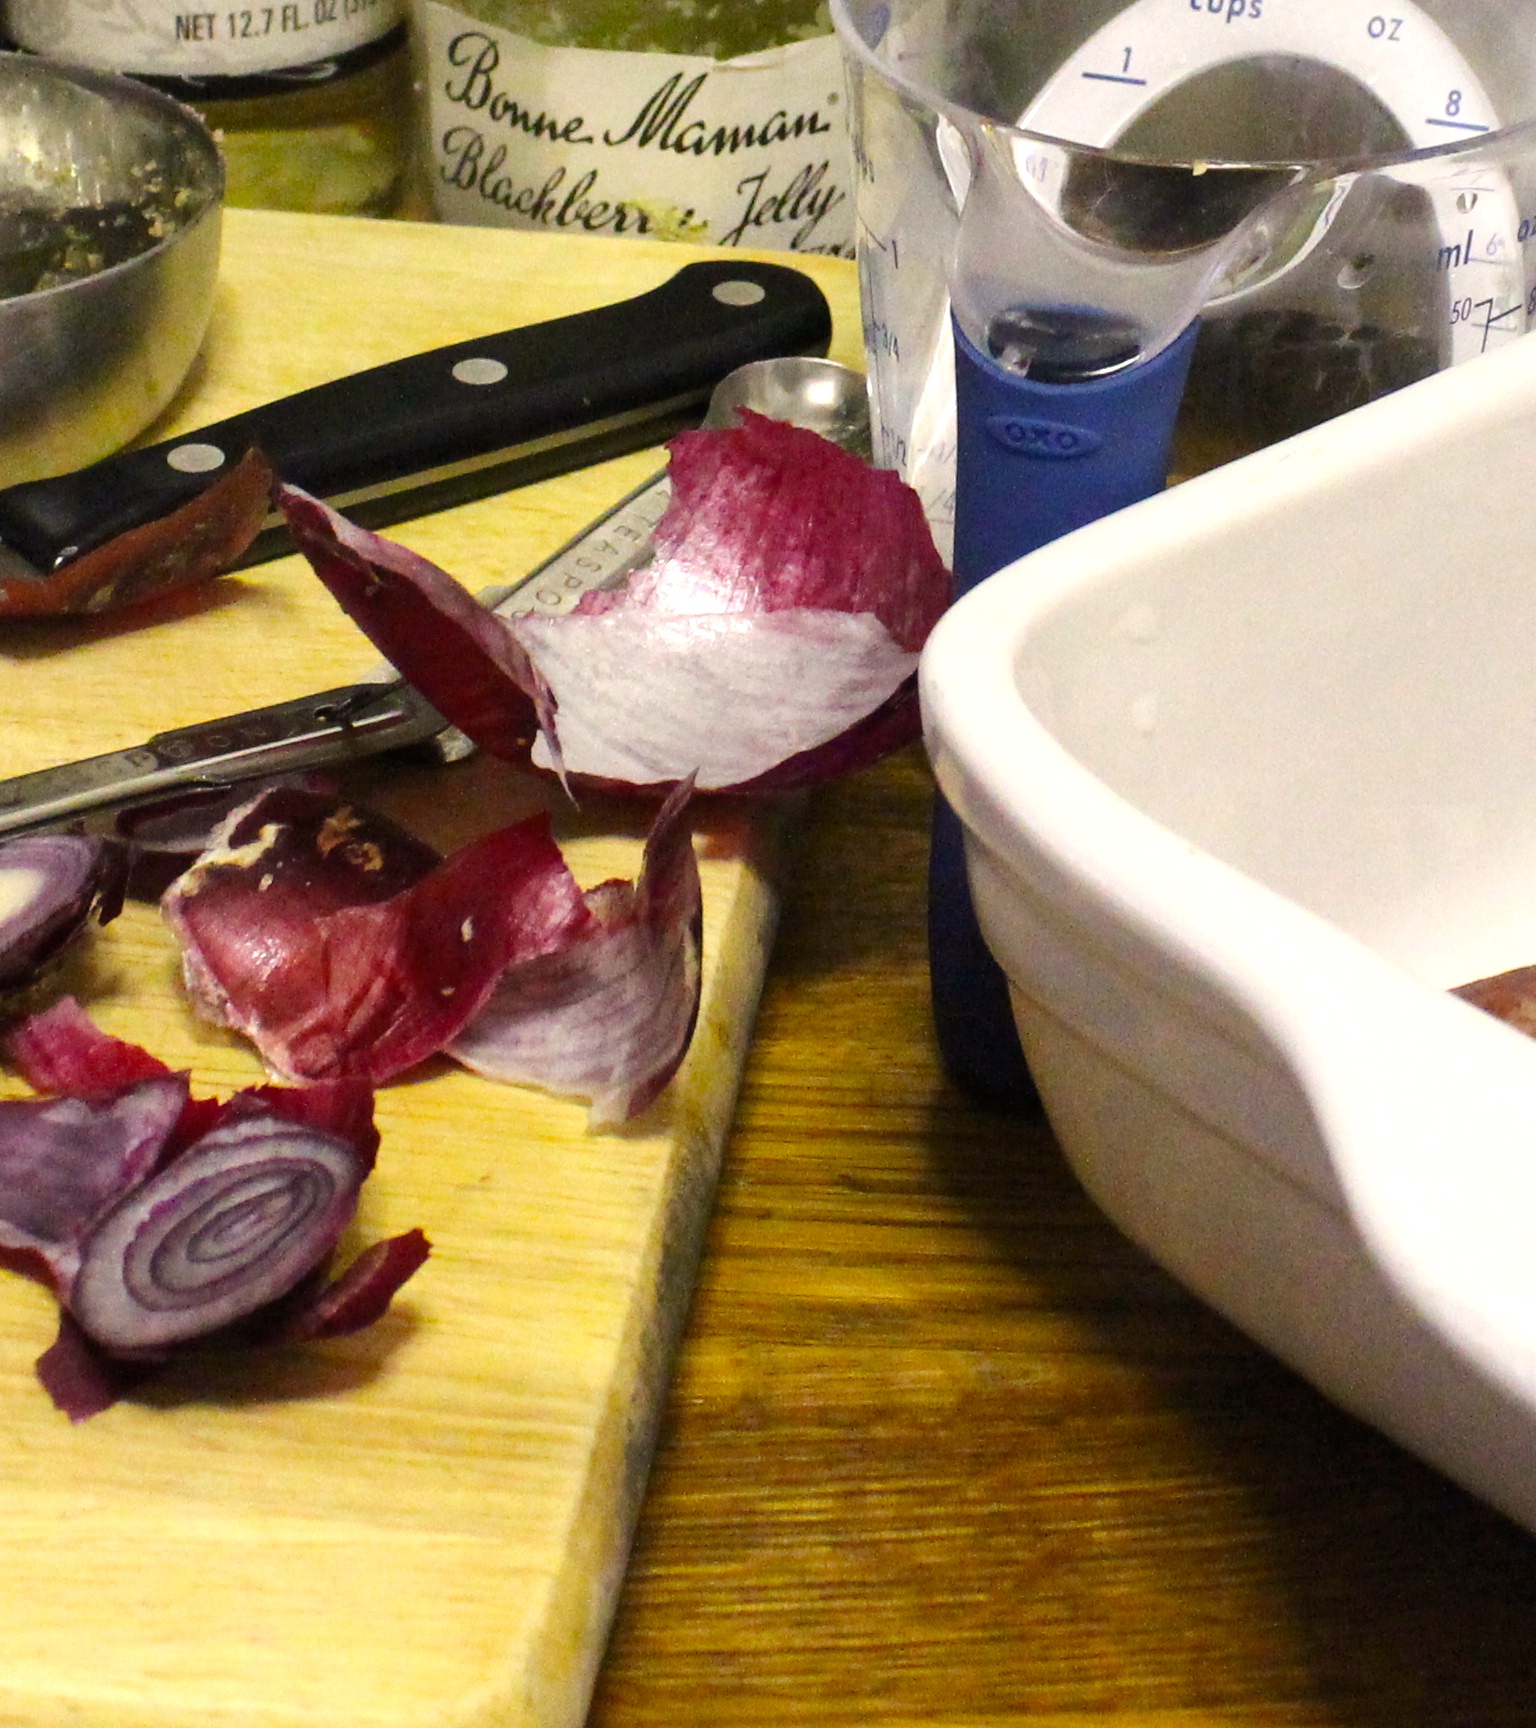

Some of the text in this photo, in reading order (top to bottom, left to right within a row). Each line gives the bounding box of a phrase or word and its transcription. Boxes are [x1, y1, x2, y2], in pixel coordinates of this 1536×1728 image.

[175, 13, 216, 41] NET
[228, 7, 274, 39] 12.7
[1121, 47, 1133, 73] 1
[445, 31, 831, 156] Bonne Maman
[1445, 90, 1463, 116] 8
[719, 160, 845, 248] Jelly
[1437, 229, 1473, 271] ml
